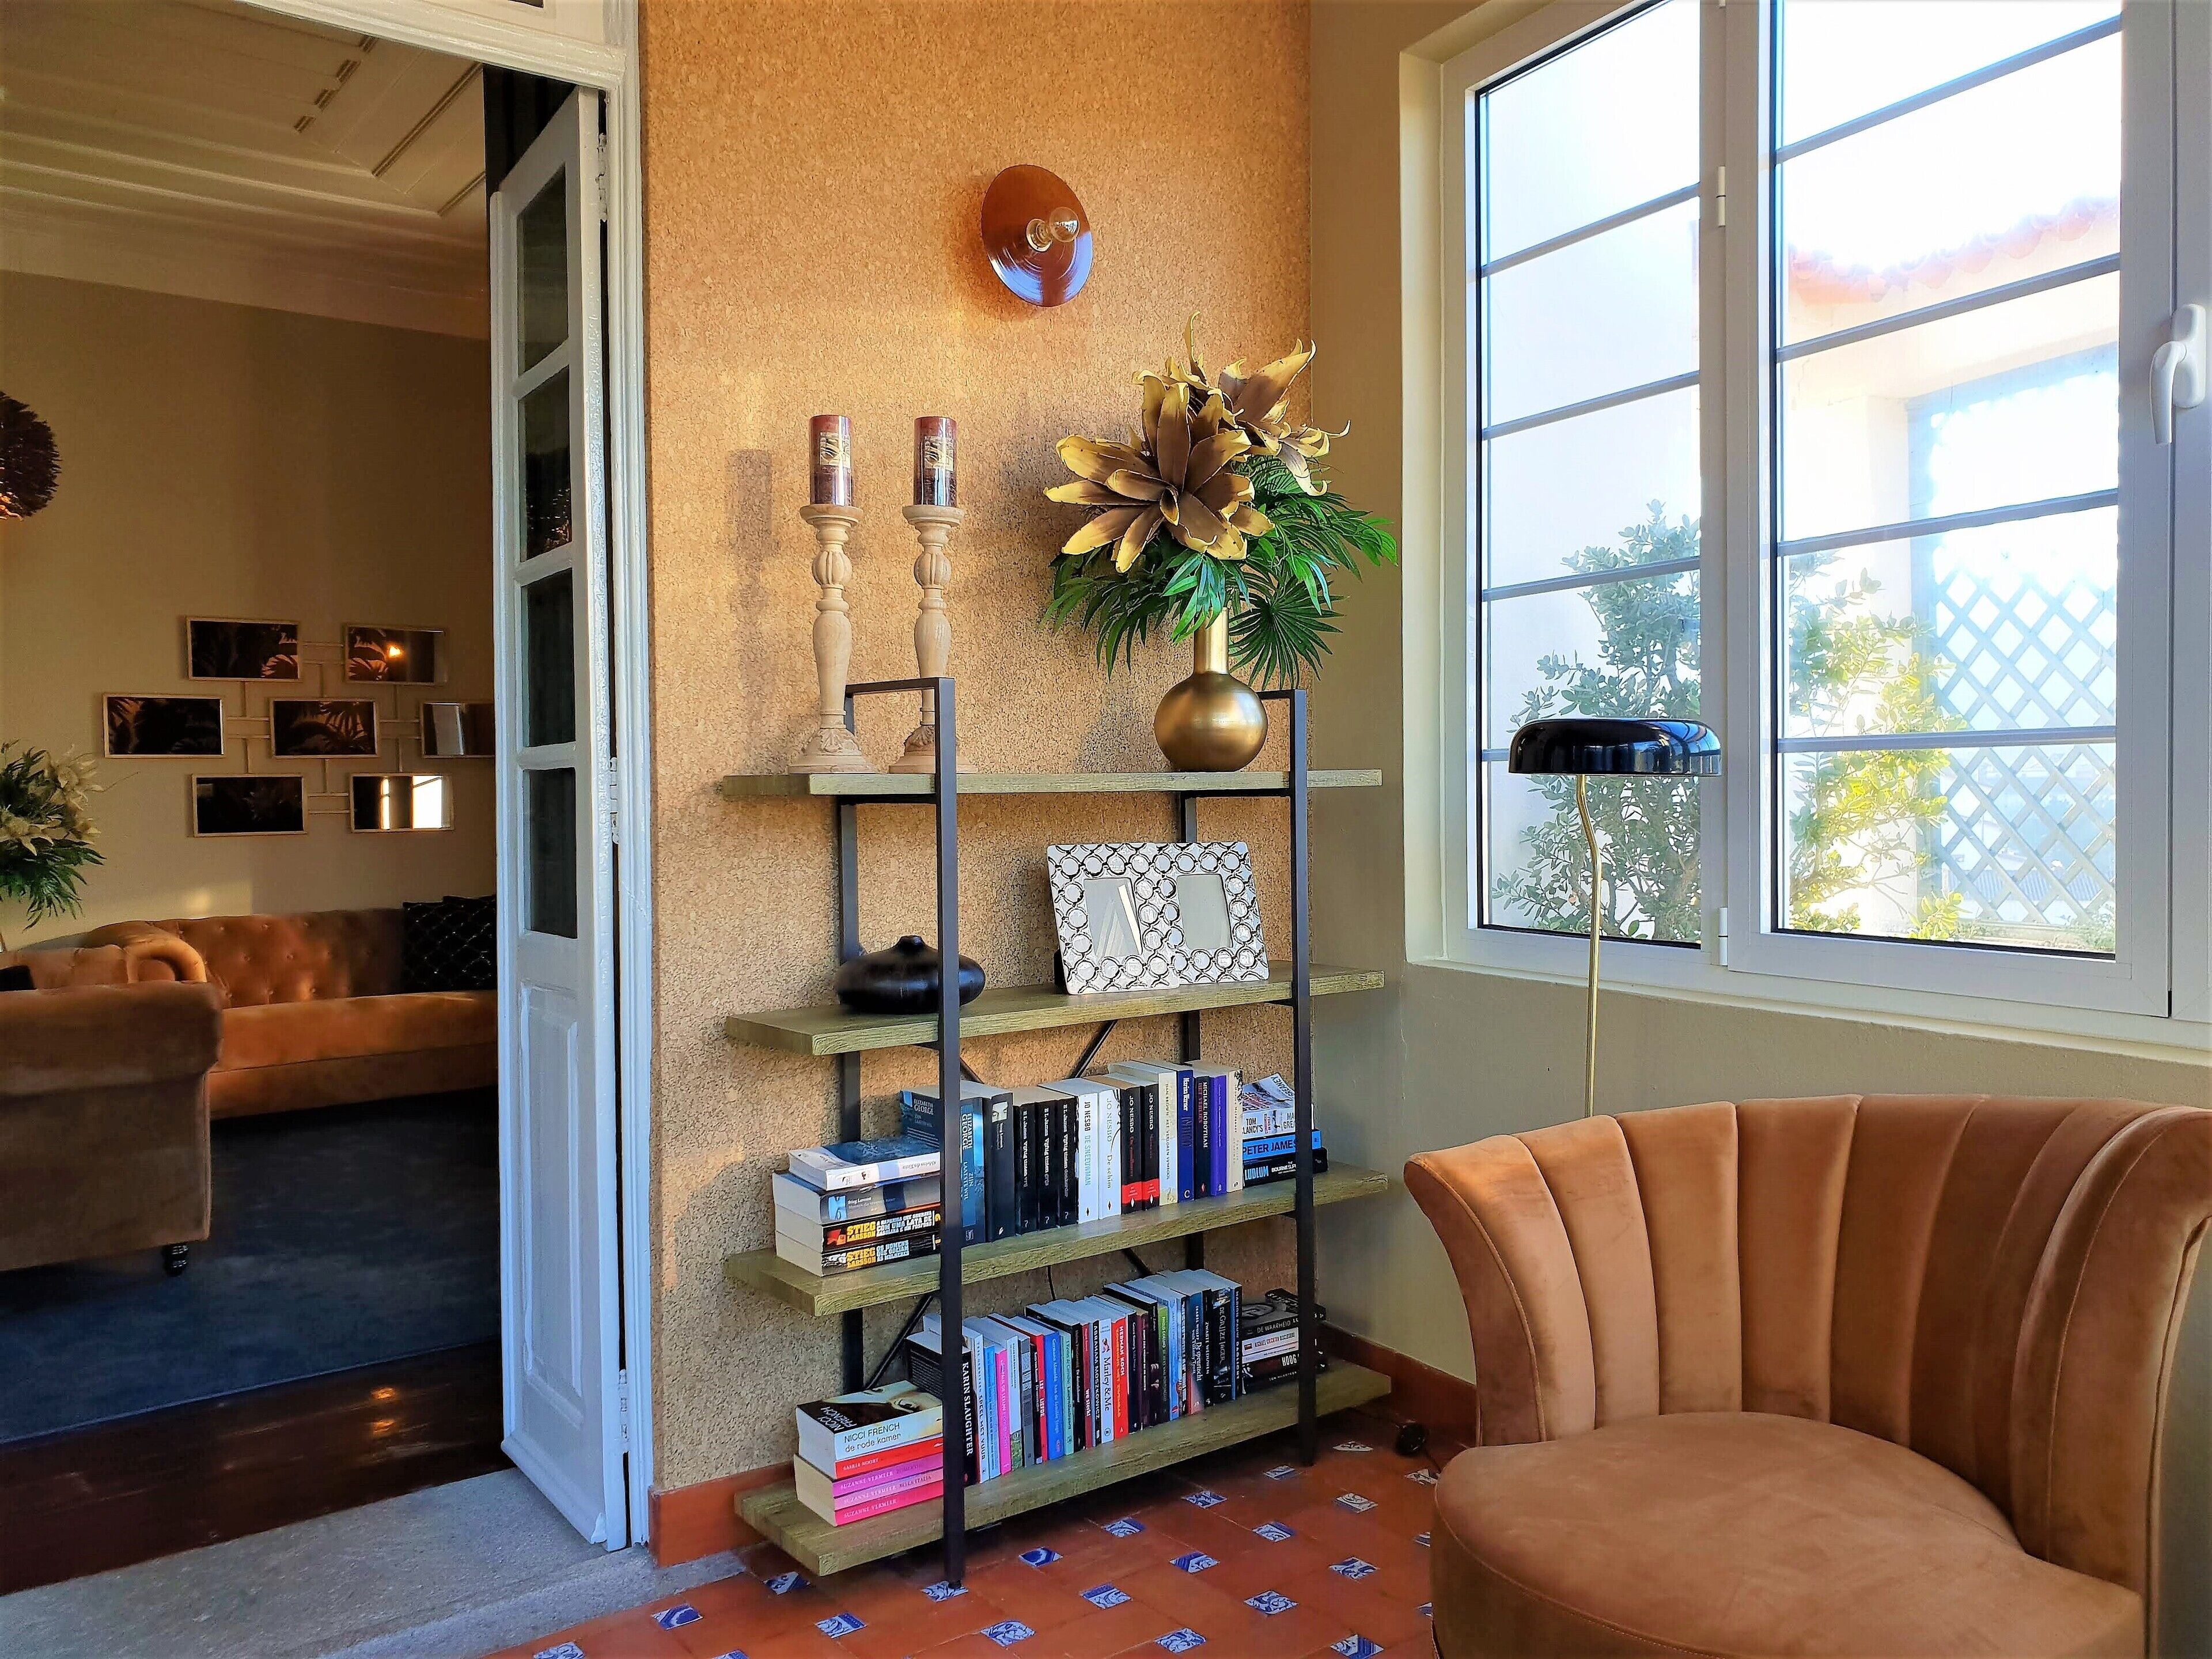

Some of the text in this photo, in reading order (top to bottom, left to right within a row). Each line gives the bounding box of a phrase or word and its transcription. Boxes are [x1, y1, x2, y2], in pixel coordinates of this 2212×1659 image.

[1129, 1095, 1134, 1105] JO
[1149, 1093, 1153, 1103] JO
[914, 1104, 934, 1115] GEORGE
[1107, 1099, 1112, 1110] JO
[1246, 1118, 1256, 1126] TOM
[1243, 1125, 1263, 1135] LANCY'S
[1085, 1135, 1091, 1143] DE
[1243, 1143, 1269, 1156] PETER
[1107, 1154, 1113, 1165] De
[1244, 1166, 1269, 1181] LUDLUM
[846, 1221, 876, 1236] STIEG
[892, 1221, 906, 1229] UMA
[906, 1218, 922, 1226] LATA
[847, 1231, 877, 1243] LARSSON
[846, 1247, 876, 1262] STIEG
[847, 1257, 877, 1268] LARSSON
[1264, 1320, 1291, 1331] WAARHEID
[1196, 1342, 1202, 1350] De
[1282, 1354, 1297, 1366] HOOG
[1103, 1357, 1111, 1411] Marley & Me
[821, 1406, 858, 1427] FRENCH
[819, 1416, 845, 1431] NICCI
[964, 1395, 974, 1456] SLAUGHTER
[844, 1422, 900, 1443] NICCI FRENCH
[844, 1433, 902, 1453] de rode kamer
[840, 1471, 893, 1490] SUZANNE VERMEER
[871, 1485, 896, 1496] VERMEER
[843, 1499, 897, 1518] SUZANNE VERMEER
